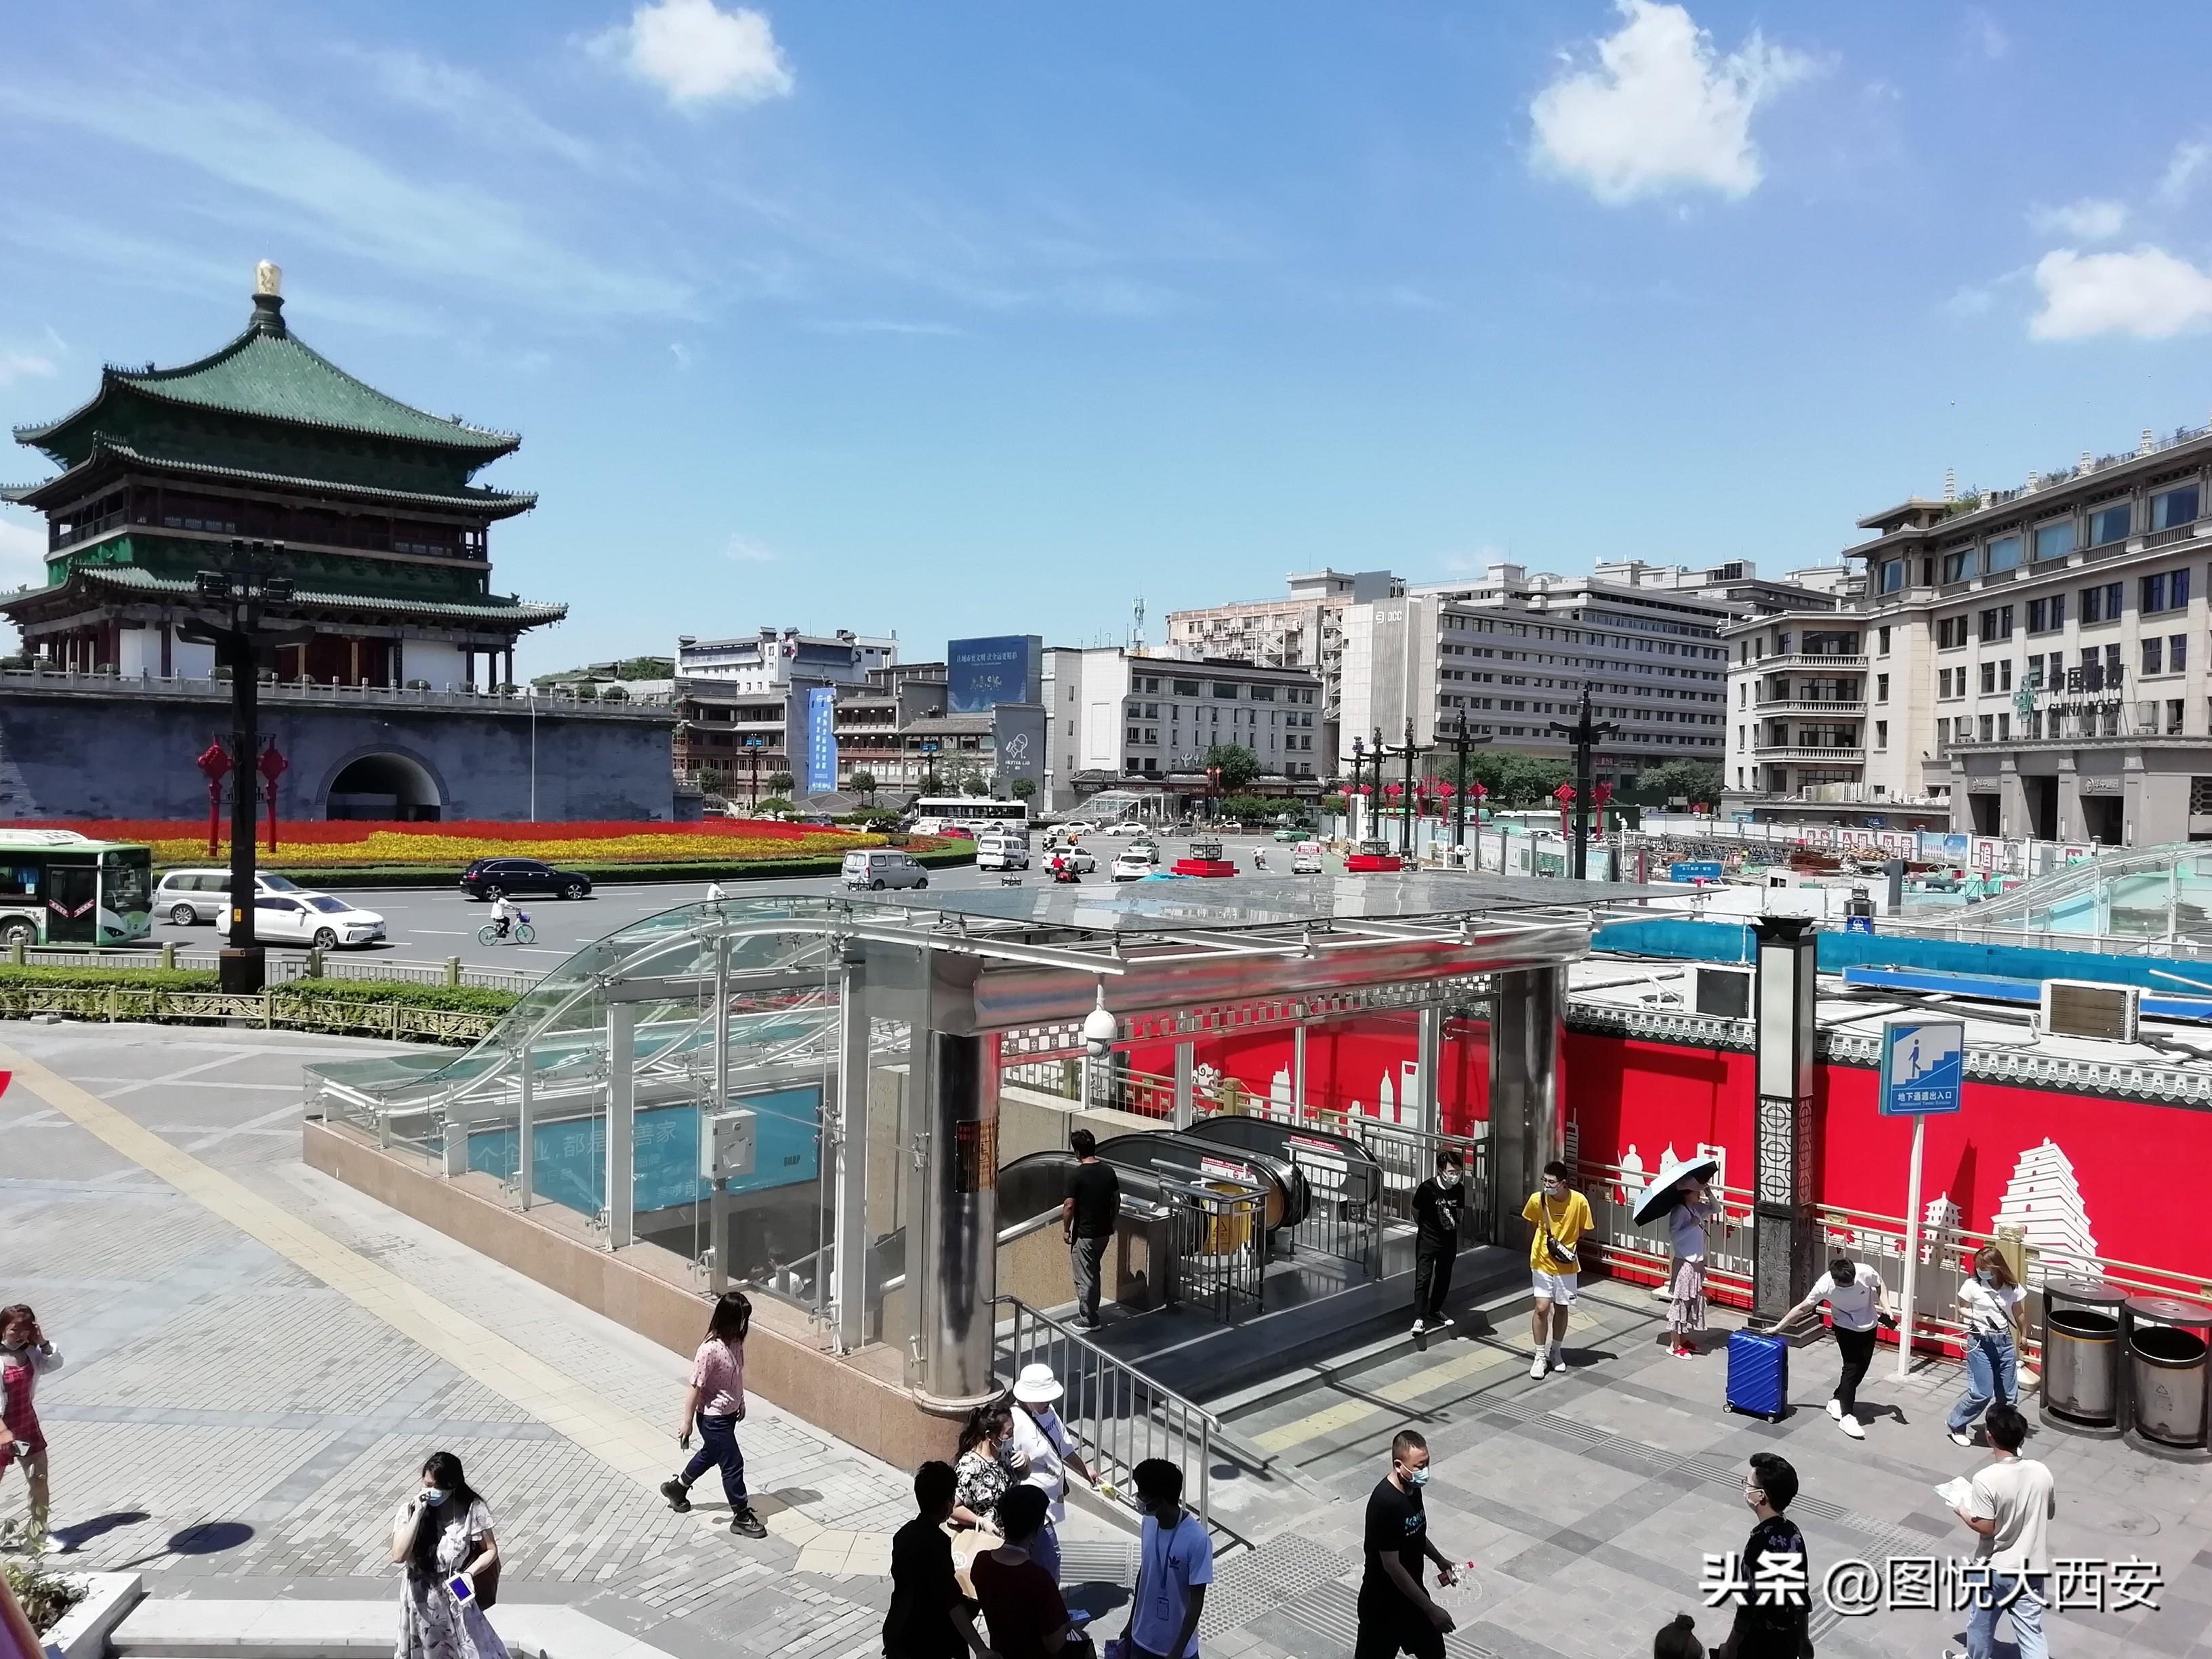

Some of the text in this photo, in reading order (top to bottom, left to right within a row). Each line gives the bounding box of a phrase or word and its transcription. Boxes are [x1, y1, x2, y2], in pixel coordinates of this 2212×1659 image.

[2049, 664, 2125, 697] 中国邮政
[2048, 701, 2083, 718] CHINA
[1898, 1091, 1952, 1101] 地下通道出入口
